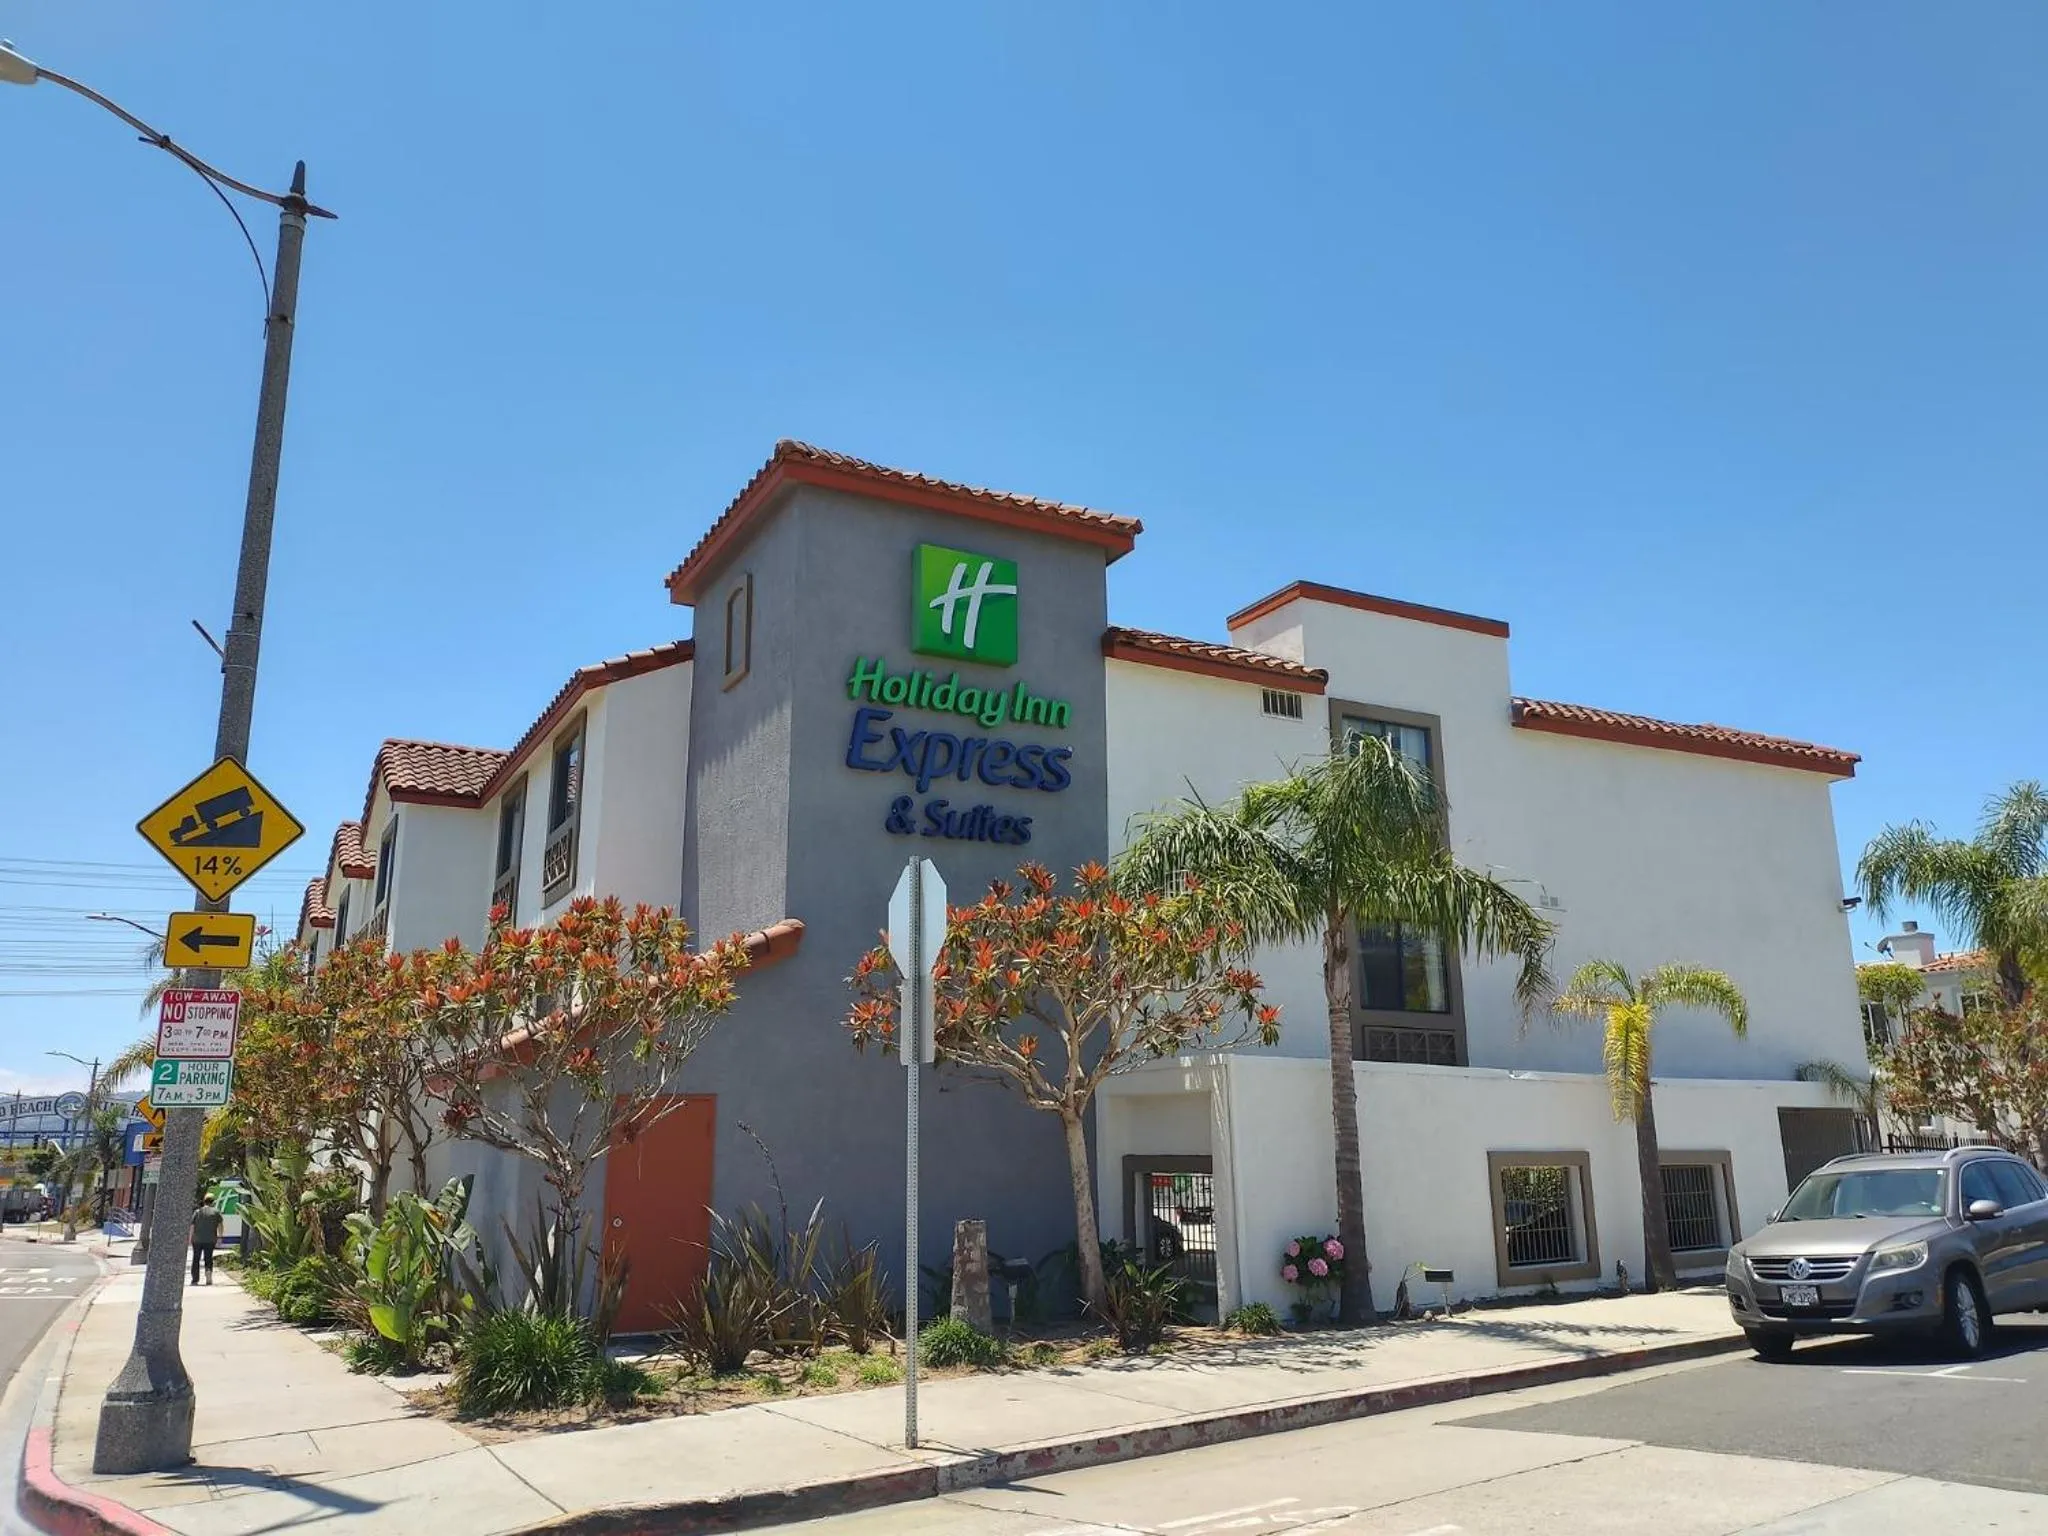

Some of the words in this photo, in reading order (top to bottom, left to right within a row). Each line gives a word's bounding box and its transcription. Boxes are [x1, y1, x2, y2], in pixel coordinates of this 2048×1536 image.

[848, 655, 1008, 729] Holiday
[1010, 680, 1073, 729] Inn
[846, 707, 1074, 794] Express
[885, 795, 917, 835] &
[920, 799, 1034, 845] Suites
[194, 855, 242, 876] 14%
[168, 992, 235, 1001] TOW-AWAY
[164, 1003, 184, 1020] NO
[187, 1006, 233, 1020] STOPPING
[159, 1063, 173, 1081] 2
[188, 1063, 219, 1072] HOUR
[180, 1072, 225, 1085] PARKING
